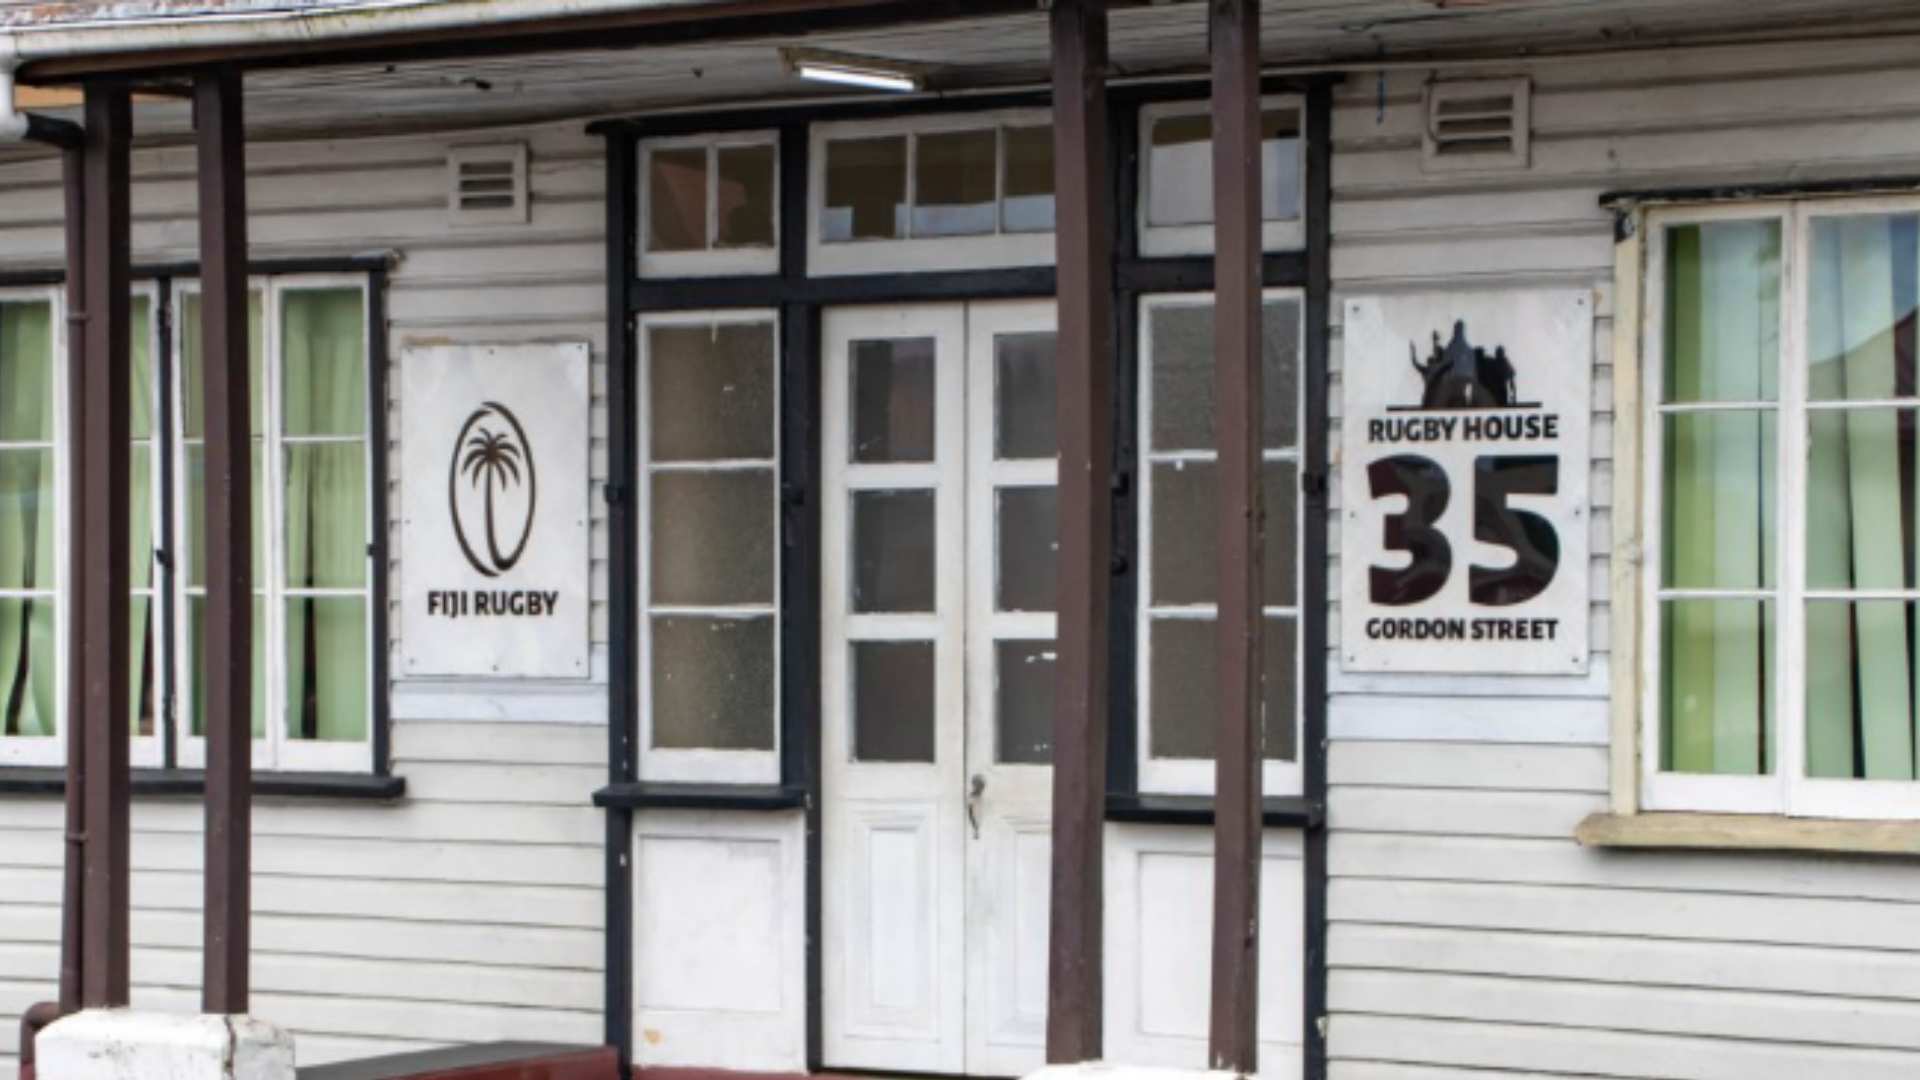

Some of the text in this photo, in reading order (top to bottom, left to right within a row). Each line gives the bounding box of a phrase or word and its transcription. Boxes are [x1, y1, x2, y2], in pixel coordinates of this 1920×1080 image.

[1367, 413, 1559, 443] RUGBY HOUSE
[1365, 453, 1561, 607] 35
[427, 590, 559, 619] FIJI RUGBY
[1365, 617, 1559, 641] GORDON STREET
